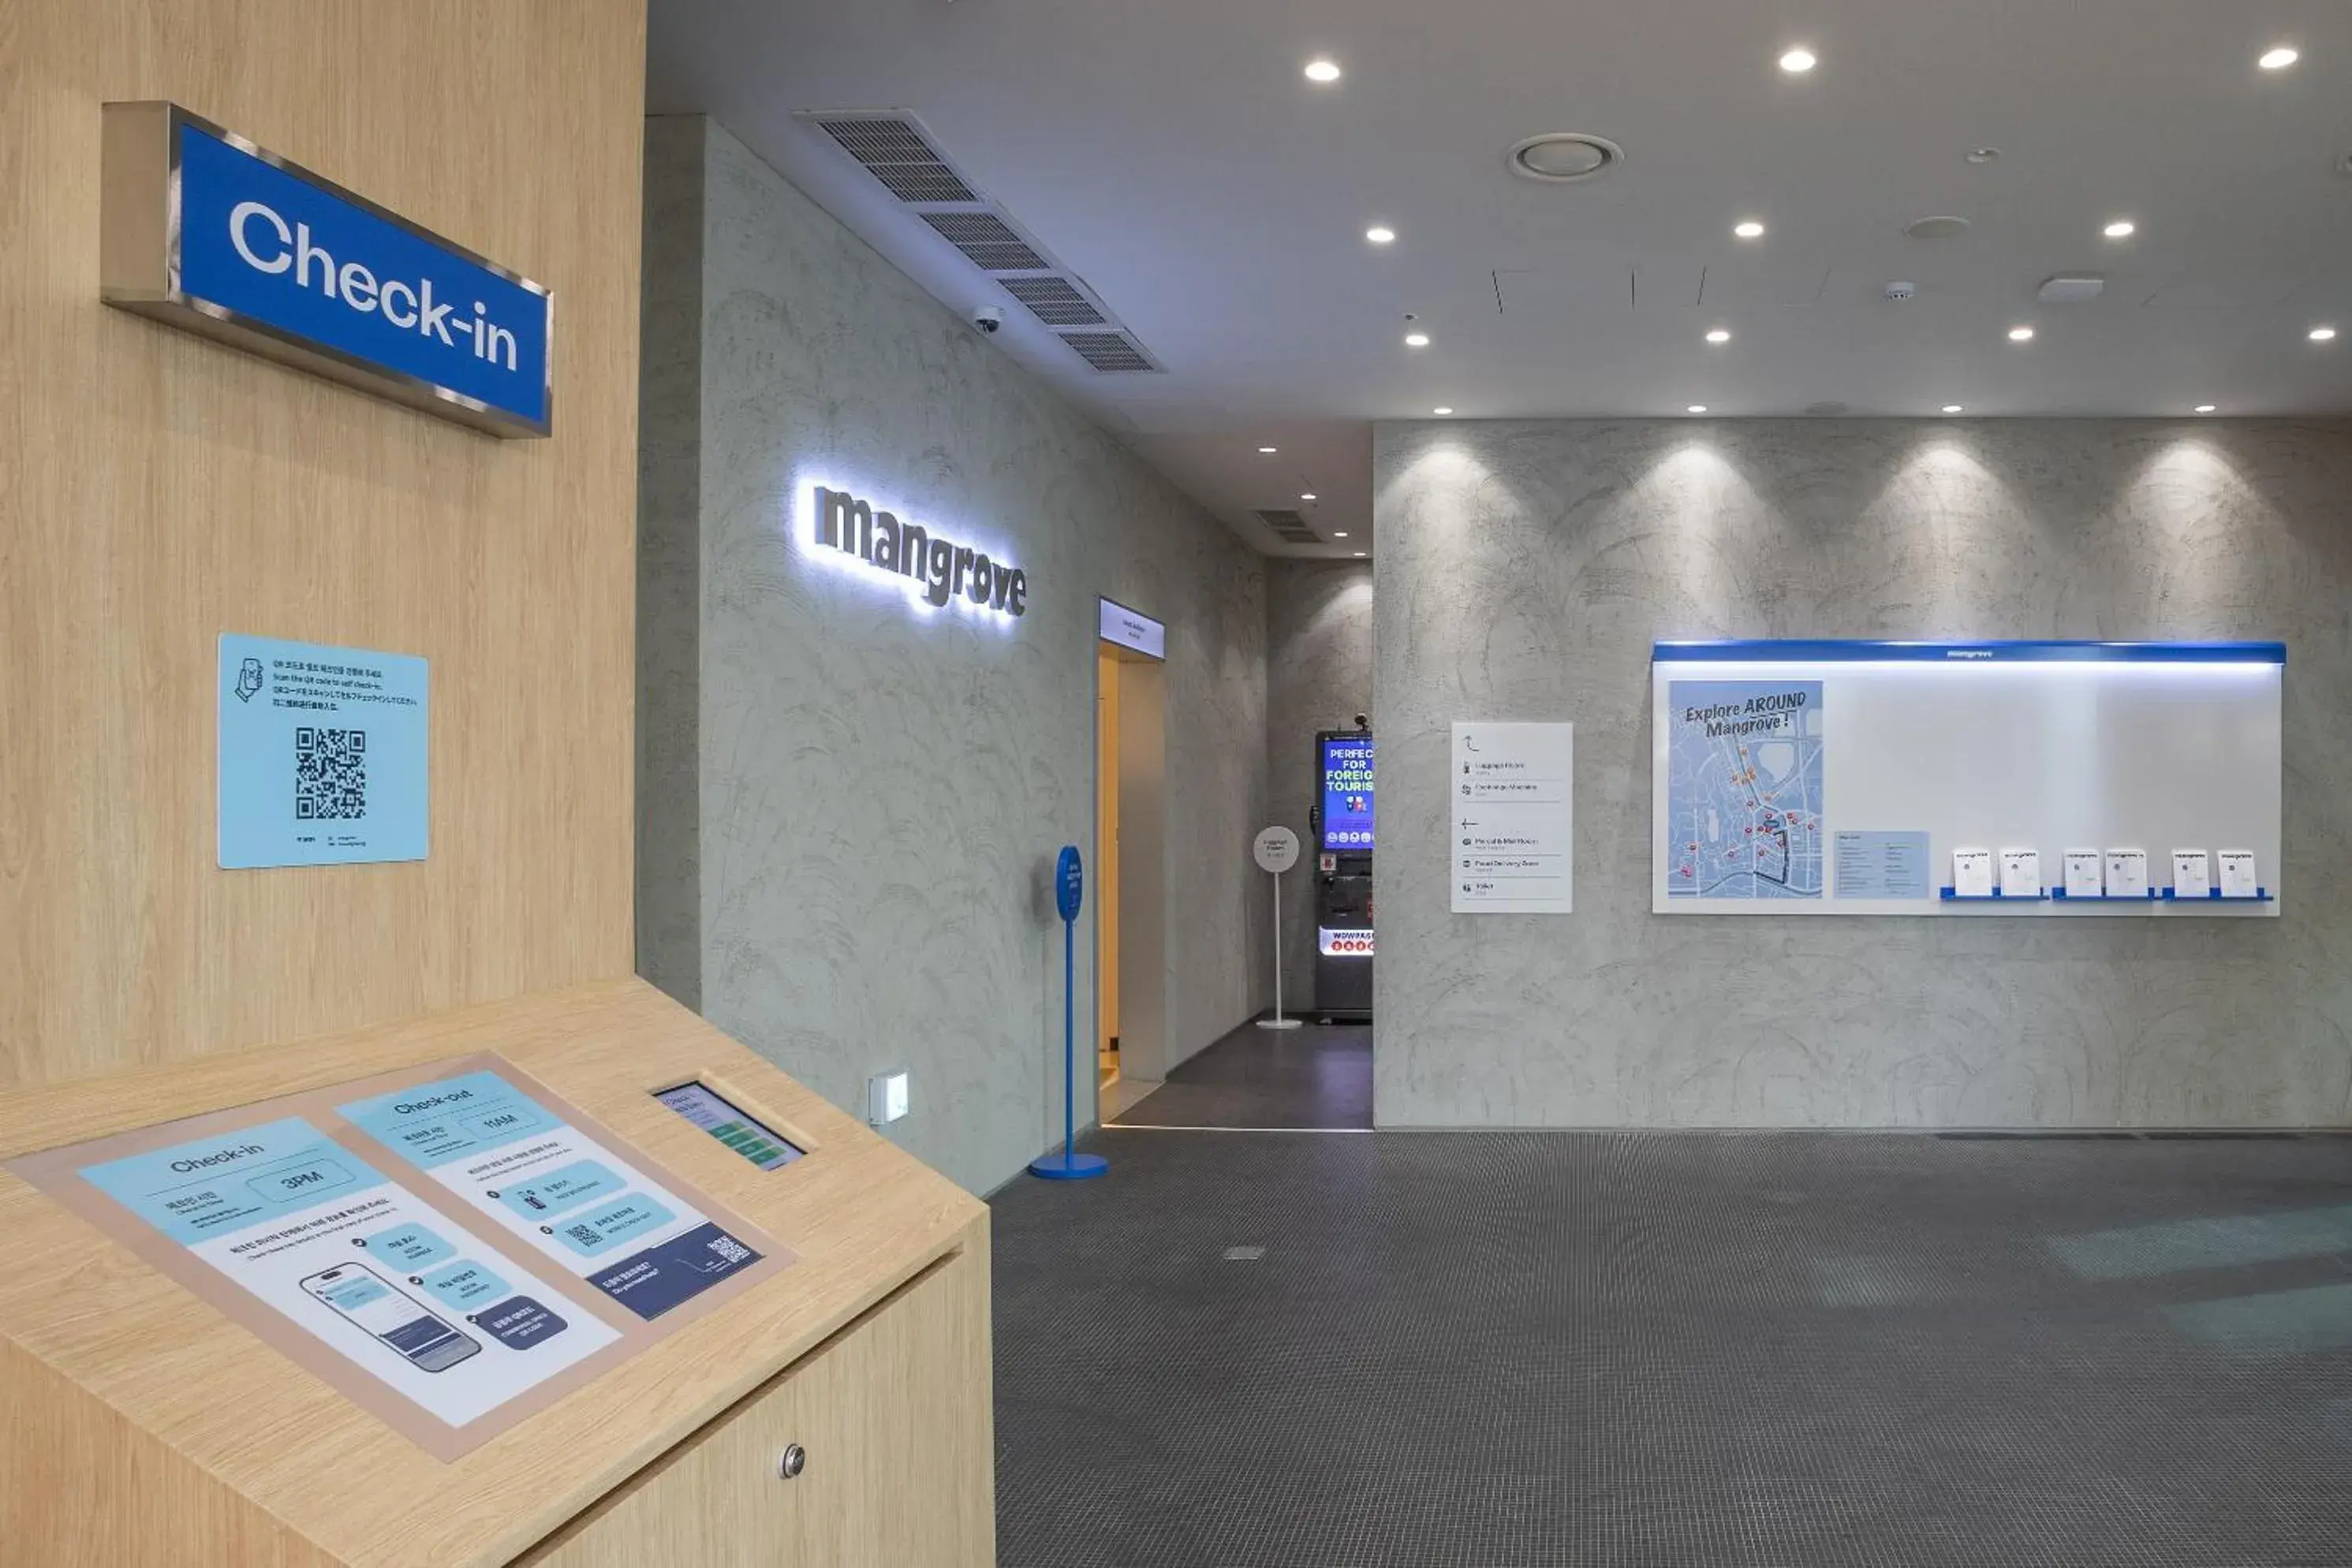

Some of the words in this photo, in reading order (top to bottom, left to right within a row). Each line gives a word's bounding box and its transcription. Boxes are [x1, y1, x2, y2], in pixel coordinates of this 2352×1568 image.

[229, 200, 517, 372] Check-in
[814, 486, 1027, 617] mangrove
[1686, 703, 1740, 723] Explore
[1743, 691, 1807, 714] AROUND
[1342, 760, 1367, 769] FOR
[394, 1089, 474, 1114] Check-out
[483, 1114, 519, 1129] 11AM
[170, 1144, 265, 1174] Check-in
[280, 1170, 324, 1190] 3PM
